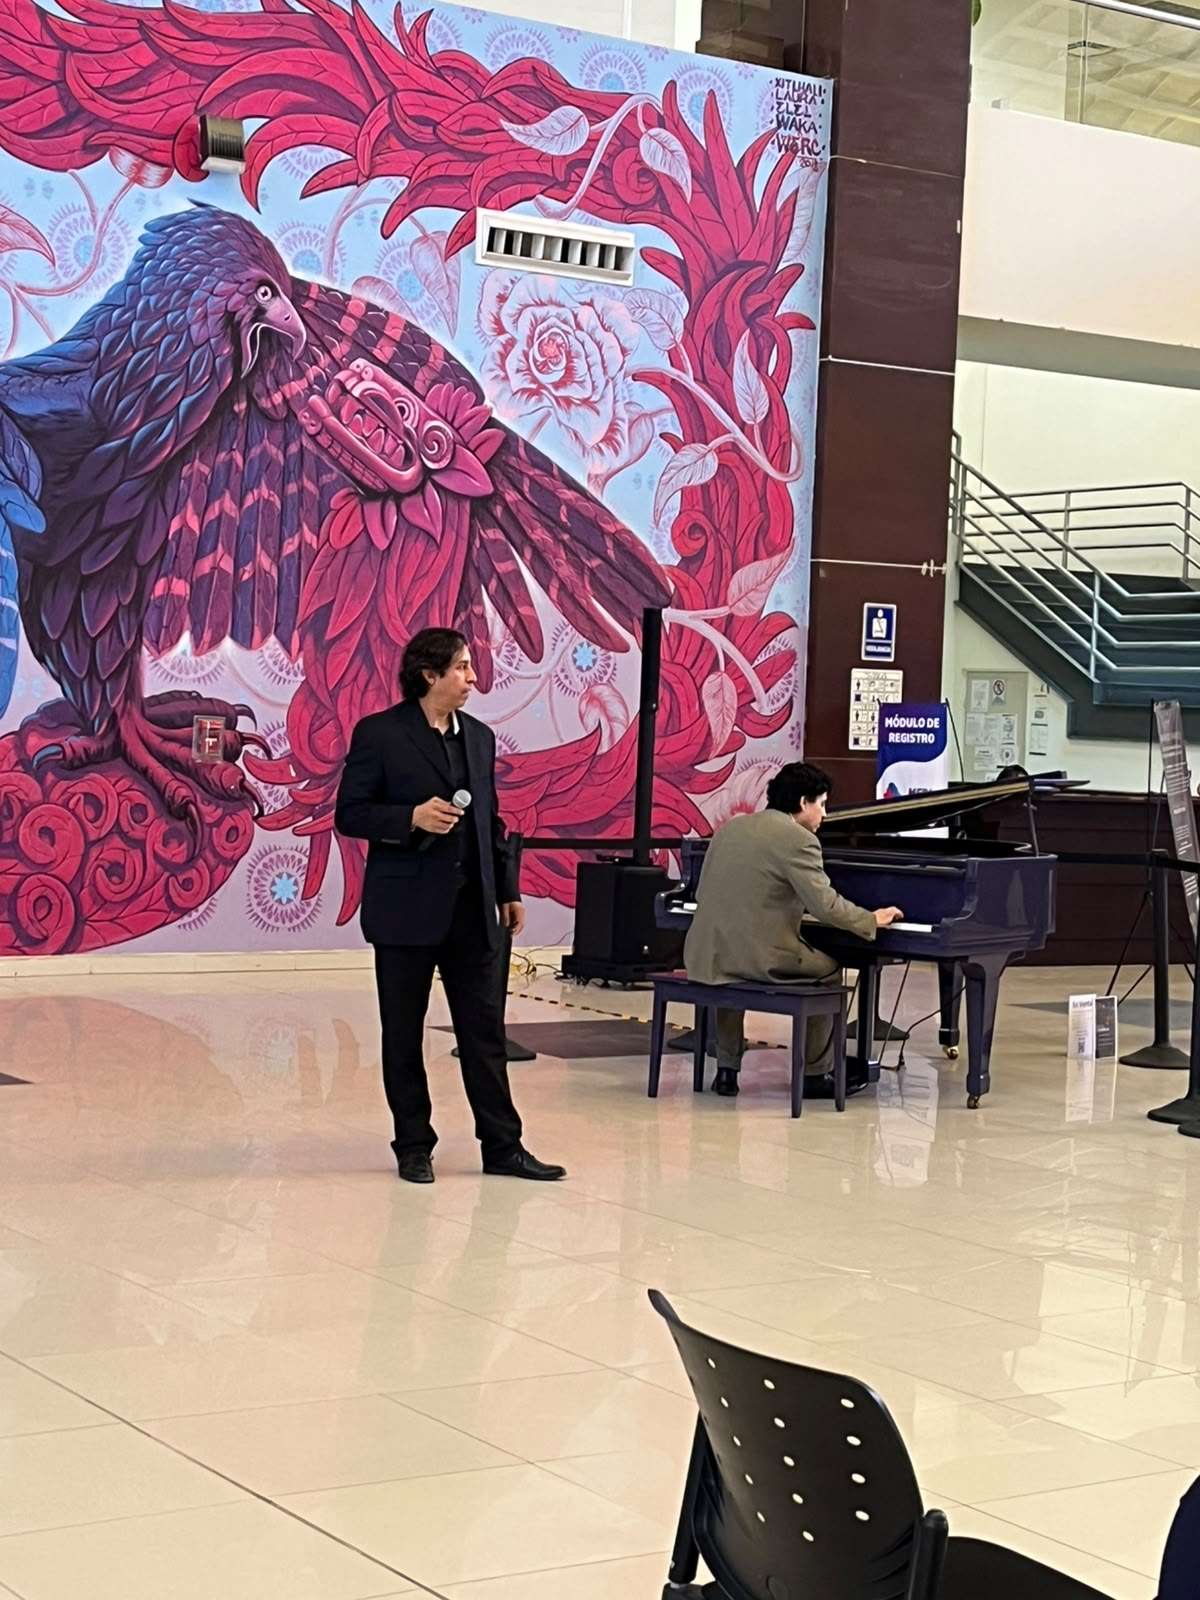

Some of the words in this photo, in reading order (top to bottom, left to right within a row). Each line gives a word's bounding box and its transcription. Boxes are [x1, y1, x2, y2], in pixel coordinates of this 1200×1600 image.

[776, 114, 818, 135] WAKA
[884, 714, 926, 729] MÓDULO
[926, 717, 940, 729] DE
[888, 732, 936, 744] REGISTRO
